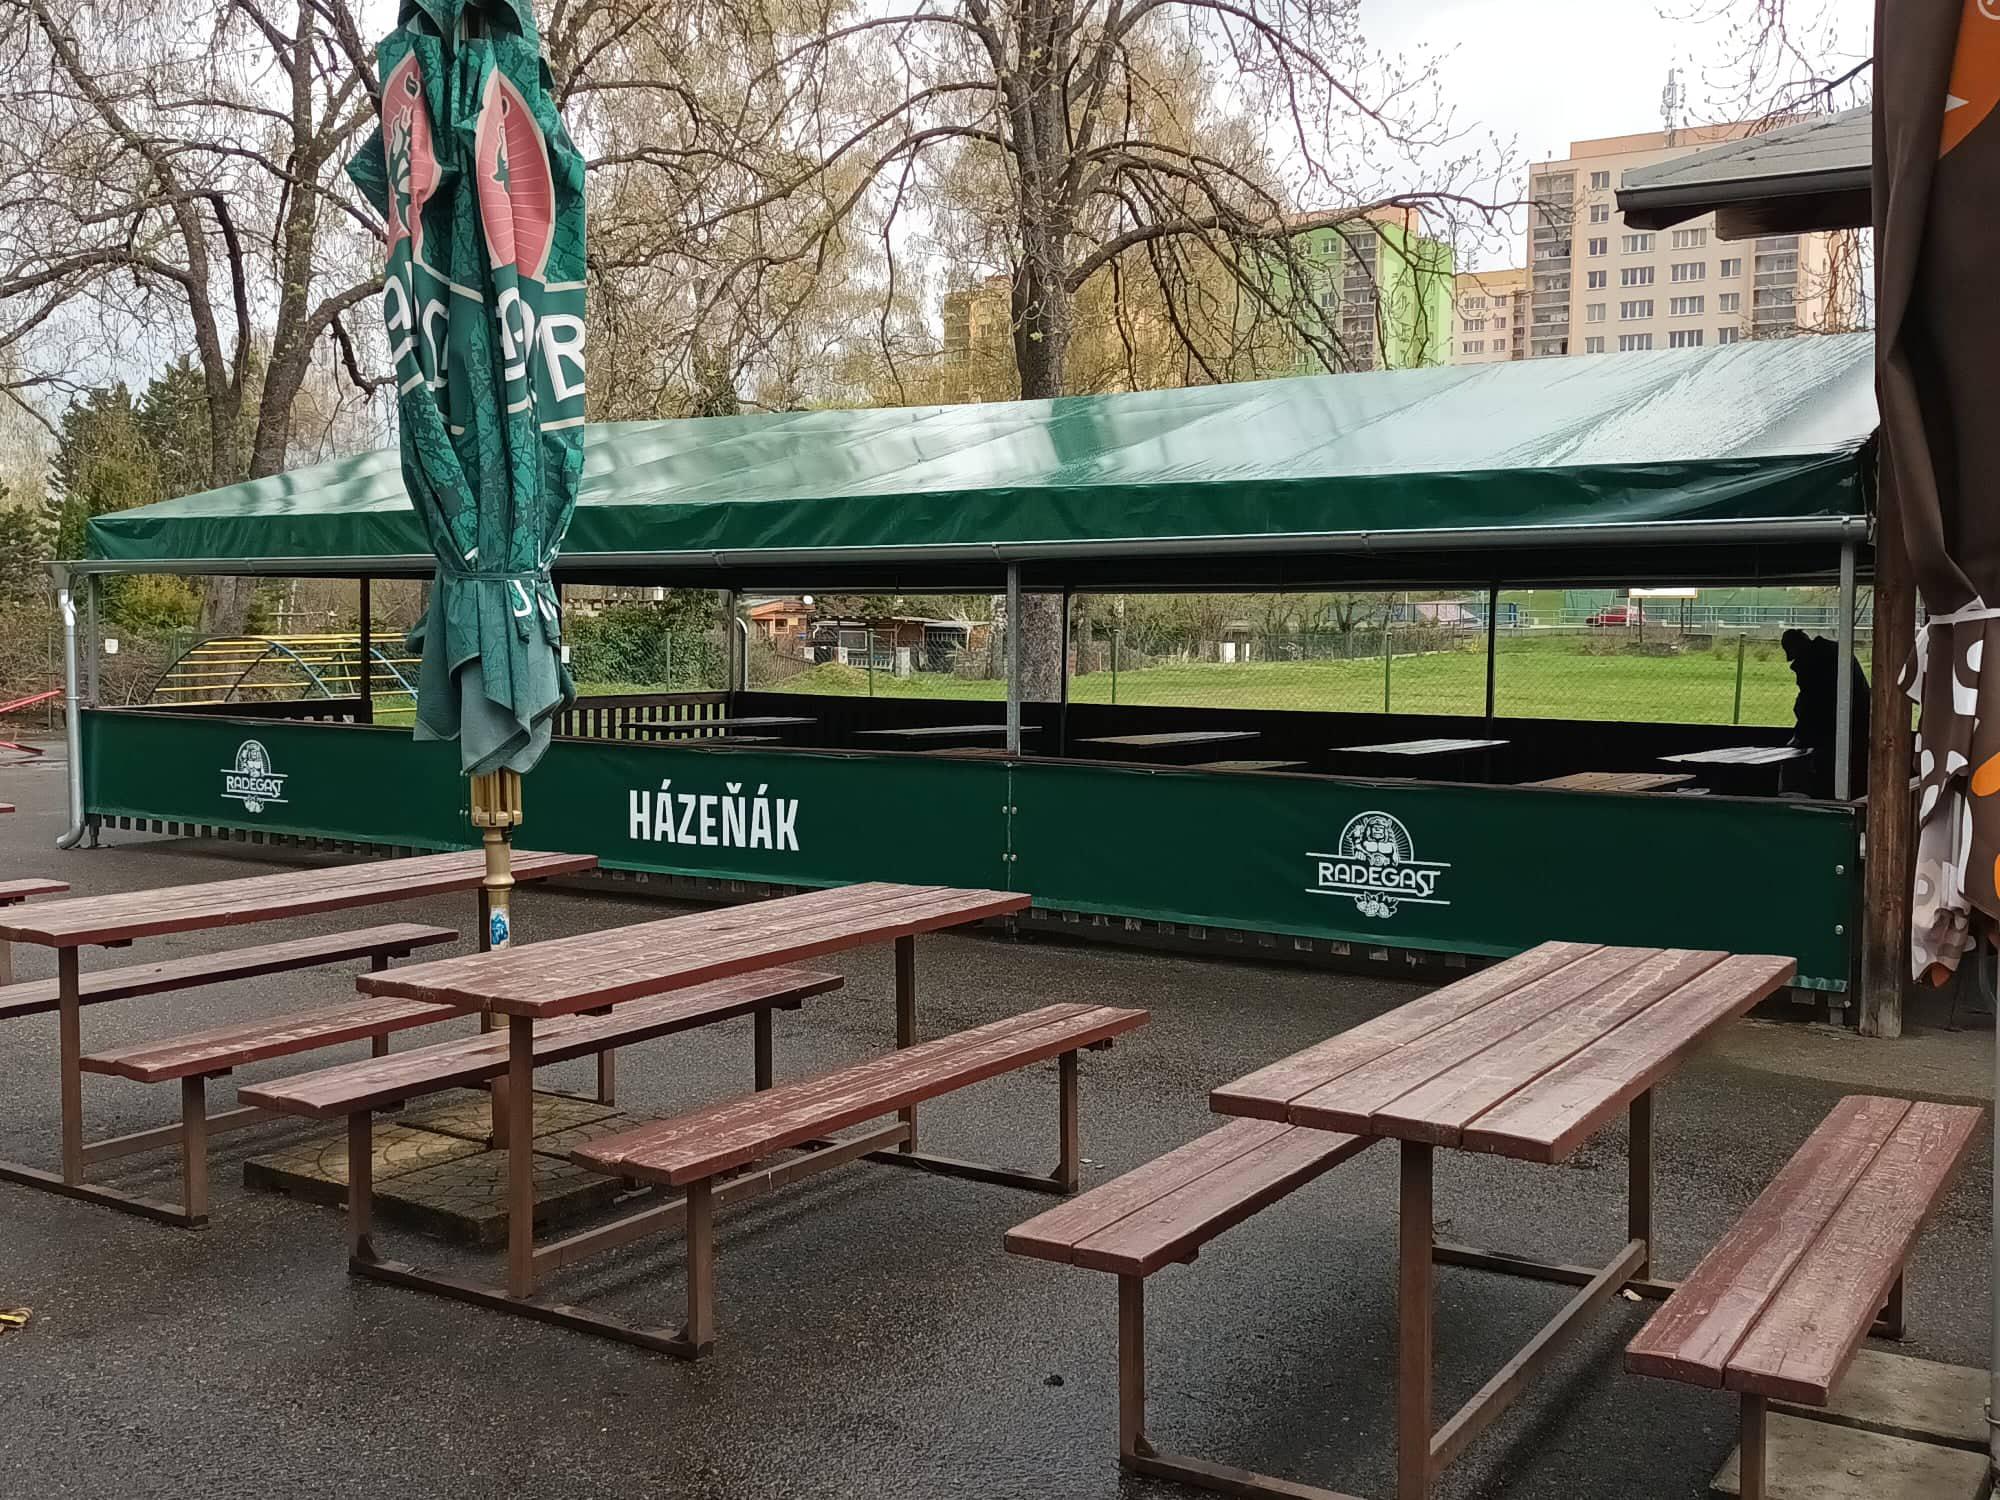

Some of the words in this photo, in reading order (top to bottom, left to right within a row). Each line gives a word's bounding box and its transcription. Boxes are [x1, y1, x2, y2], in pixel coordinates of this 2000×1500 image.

[226, 775, 284, 798] RADEGAST
[629, 778, 800, 851] HÁZEŇÁK
[1318, 861, 1441, 897] RADEGAST
